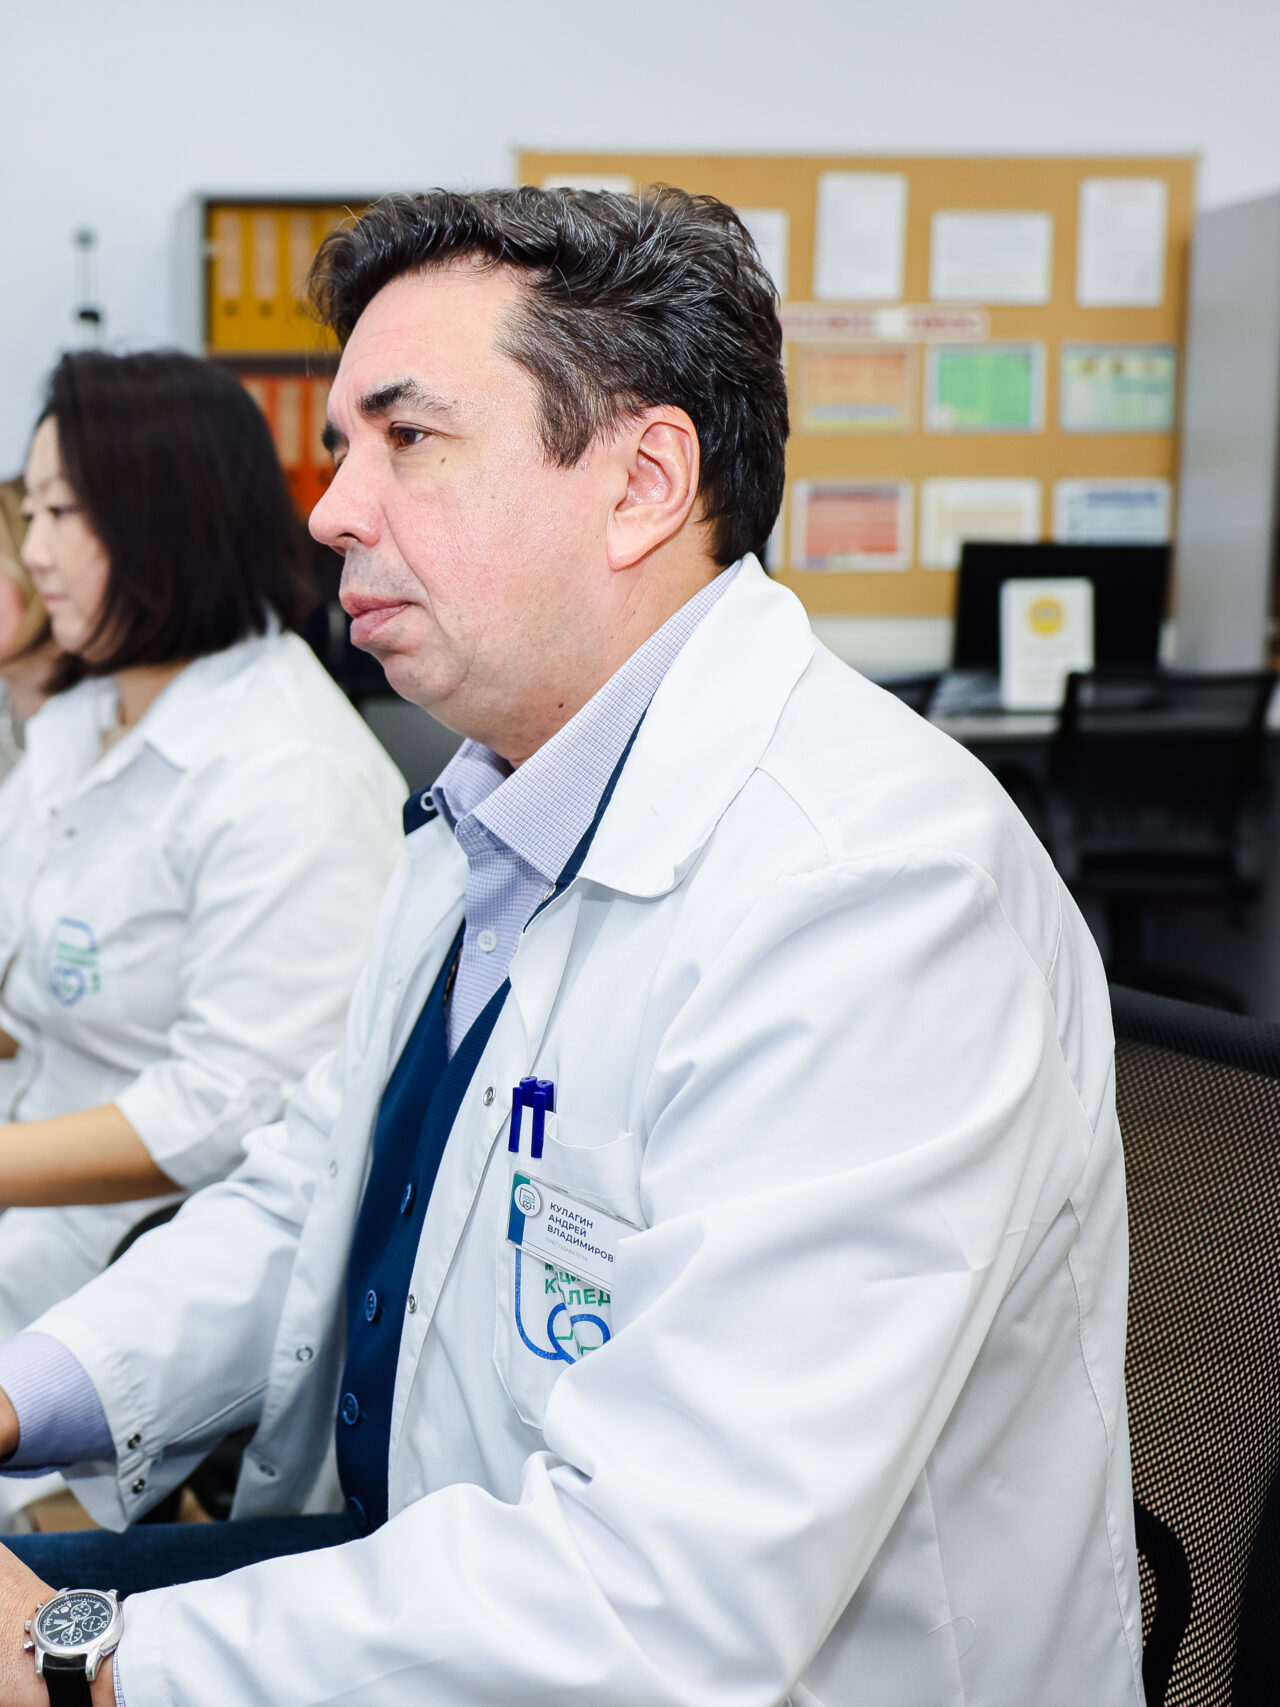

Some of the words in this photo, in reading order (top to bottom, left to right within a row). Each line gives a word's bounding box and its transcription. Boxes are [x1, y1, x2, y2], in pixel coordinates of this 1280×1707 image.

[548, 1213, 587, 1238] АНДРЕЙ
[550, 1201, 594, 1230] КУЛАГИН
[547, 1224, 616, 1264] ВЛАДИМИРОВ
